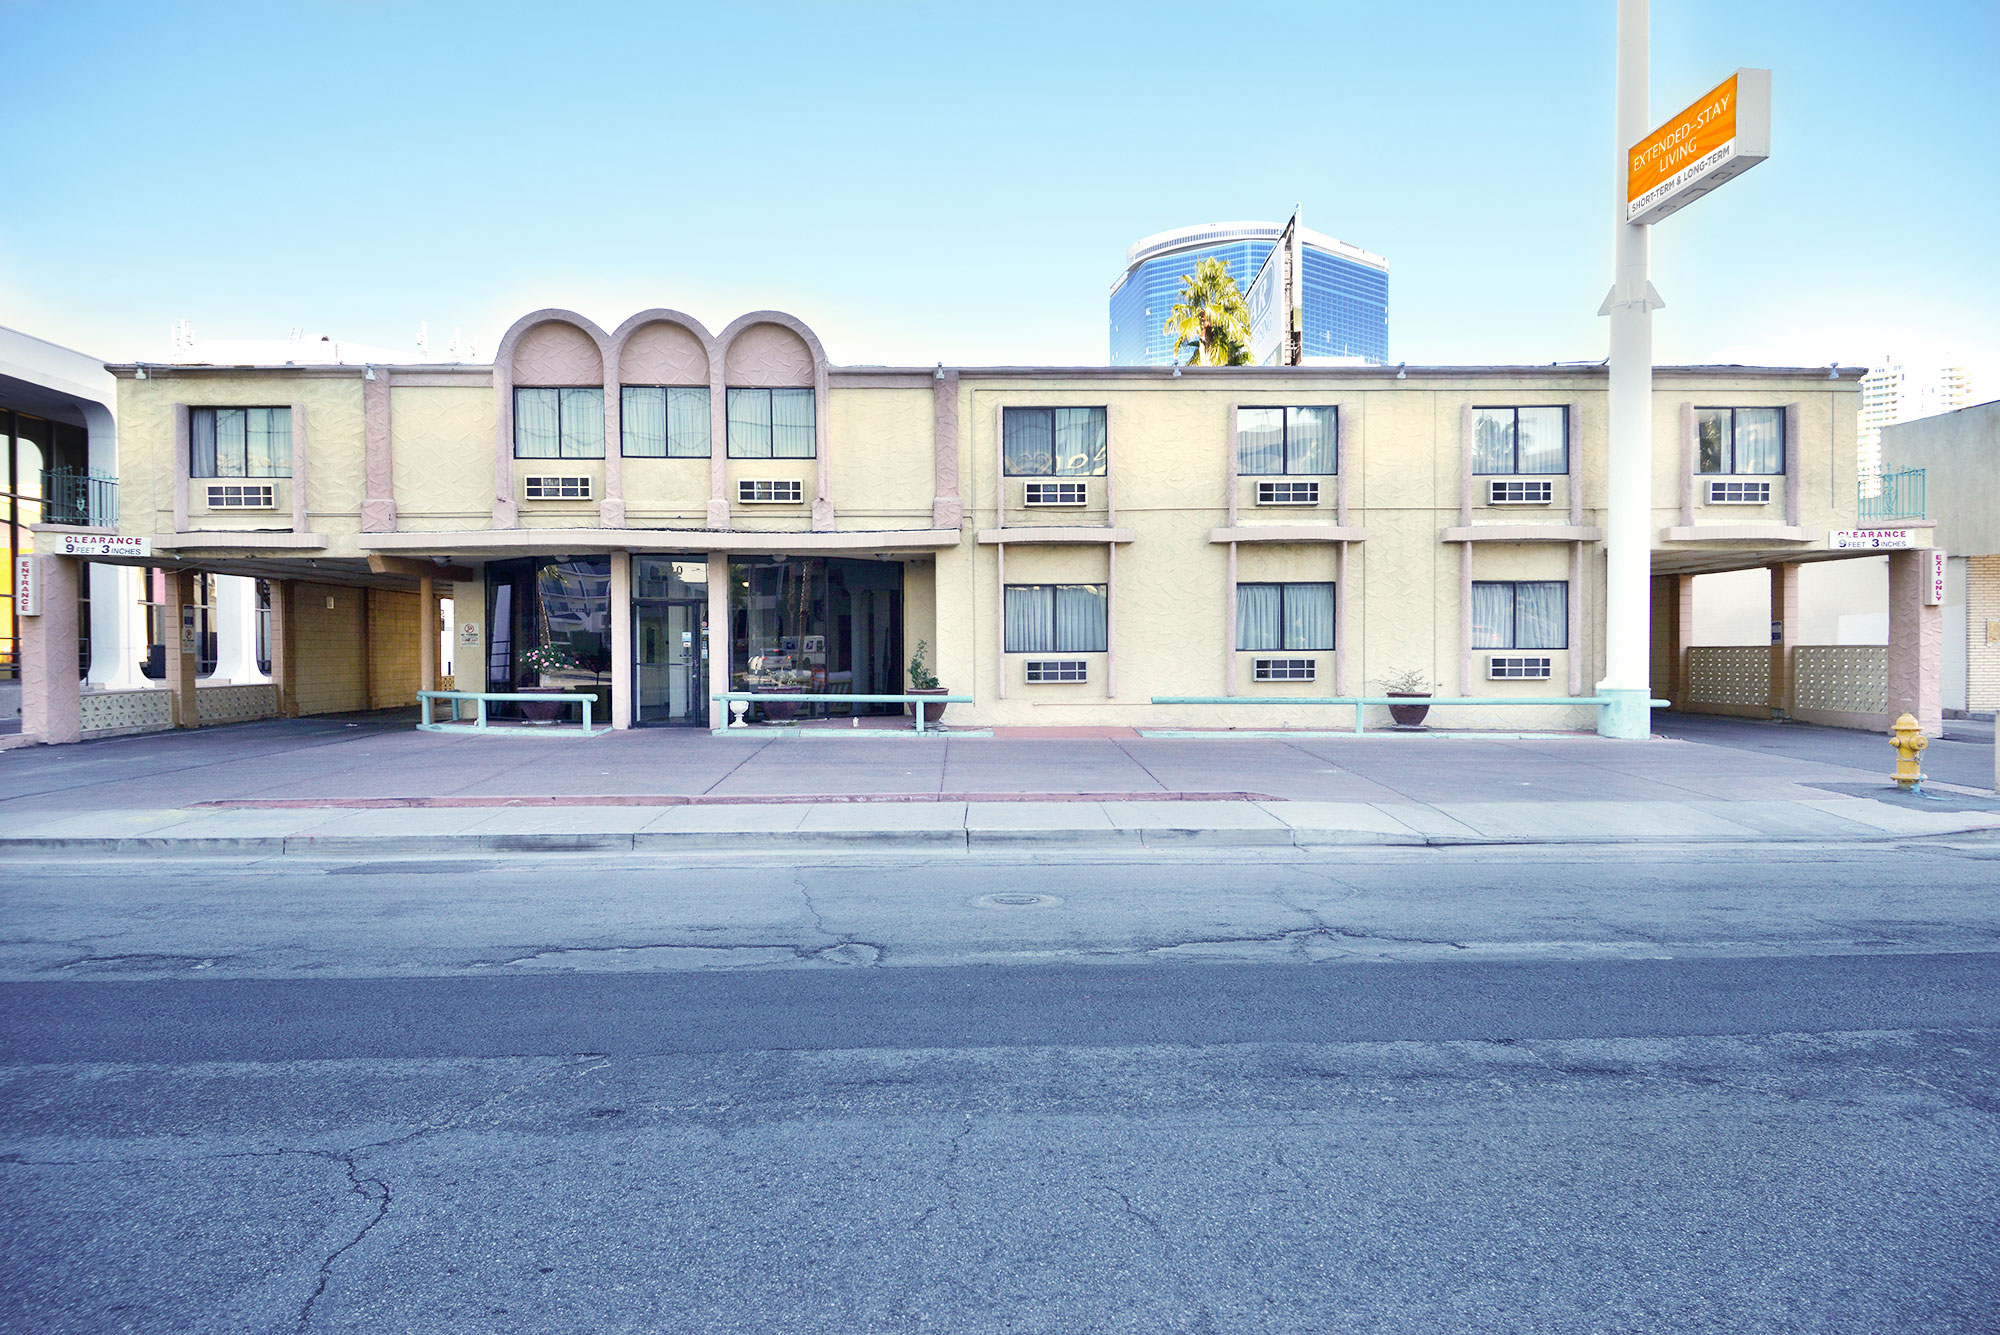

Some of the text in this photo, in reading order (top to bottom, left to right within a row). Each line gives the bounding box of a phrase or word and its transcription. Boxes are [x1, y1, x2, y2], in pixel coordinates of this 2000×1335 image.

[1633, 93, 1730, 172] EXTENDED-STAY
[1659, 136, 1697, 173] LIVING
[1631, 145, 1730, 213] SHORT-TERM & LONG-TERM
[65, 535, 142, 545] CLEARANCE
[65, 543, 142, 556] 9 FEET 3 INCHES
[1838, 538, 1847, 548] 9
[1871, 538, 1880, 548] 3
[21, 560, 30, 611] ENTRANCE
[1935, 554, 1943, 601] EXIT ONLY
